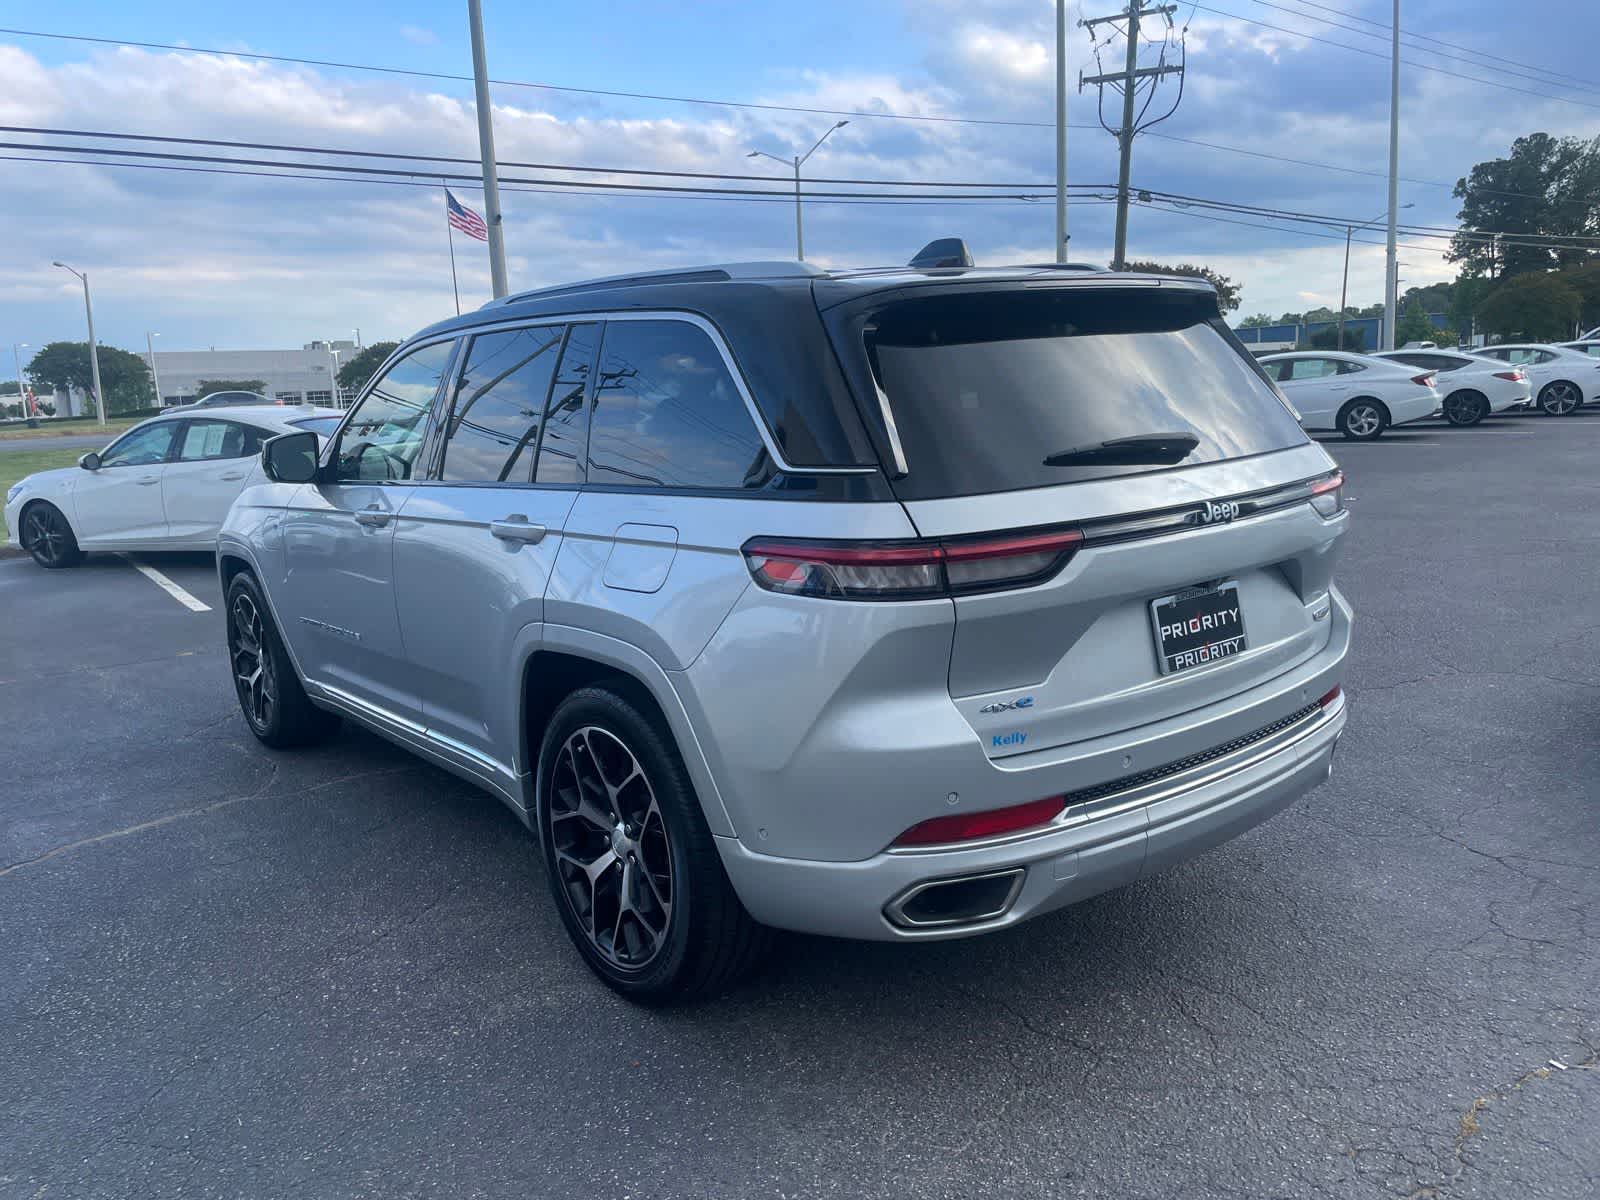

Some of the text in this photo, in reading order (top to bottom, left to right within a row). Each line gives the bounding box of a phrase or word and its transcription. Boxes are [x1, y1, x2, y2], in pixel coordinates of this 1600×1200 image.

[1202, 501, 1240, 523] Jeep
[1161, 608, 1239, 641] PRIORITY
[1175, 640, 1240, 670] PRIORITY
[992, 731, 1028, 746] Kelly
